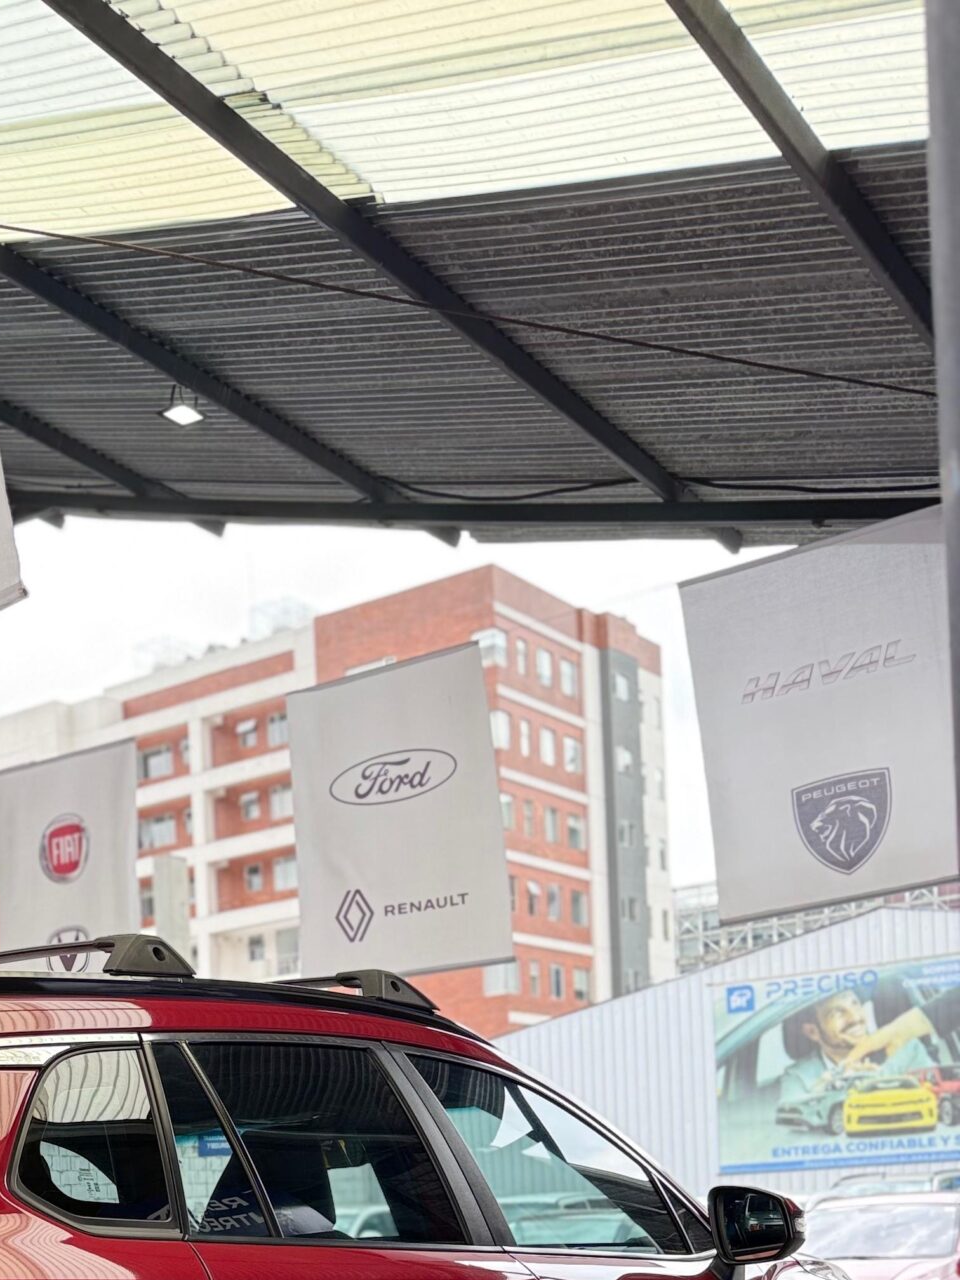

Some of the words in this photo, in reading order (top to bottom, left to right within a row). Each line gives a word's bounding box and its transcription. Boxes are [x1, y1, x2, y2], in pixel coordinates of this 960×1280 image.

[740, 639, 917, 705] HAVAL
[354, 757, 431, 800] Ford
[801, 777, 881, 802] PEUGEOT
[51, 832, 80, 867] FIAT
[384, 892, 469, 917] RENAULT
[766, 970, 878, 998] PRECISO
[771, 1144, 842, 1159] ENTREGA
[846, 1136, 936, 1154] CONFIABLE
